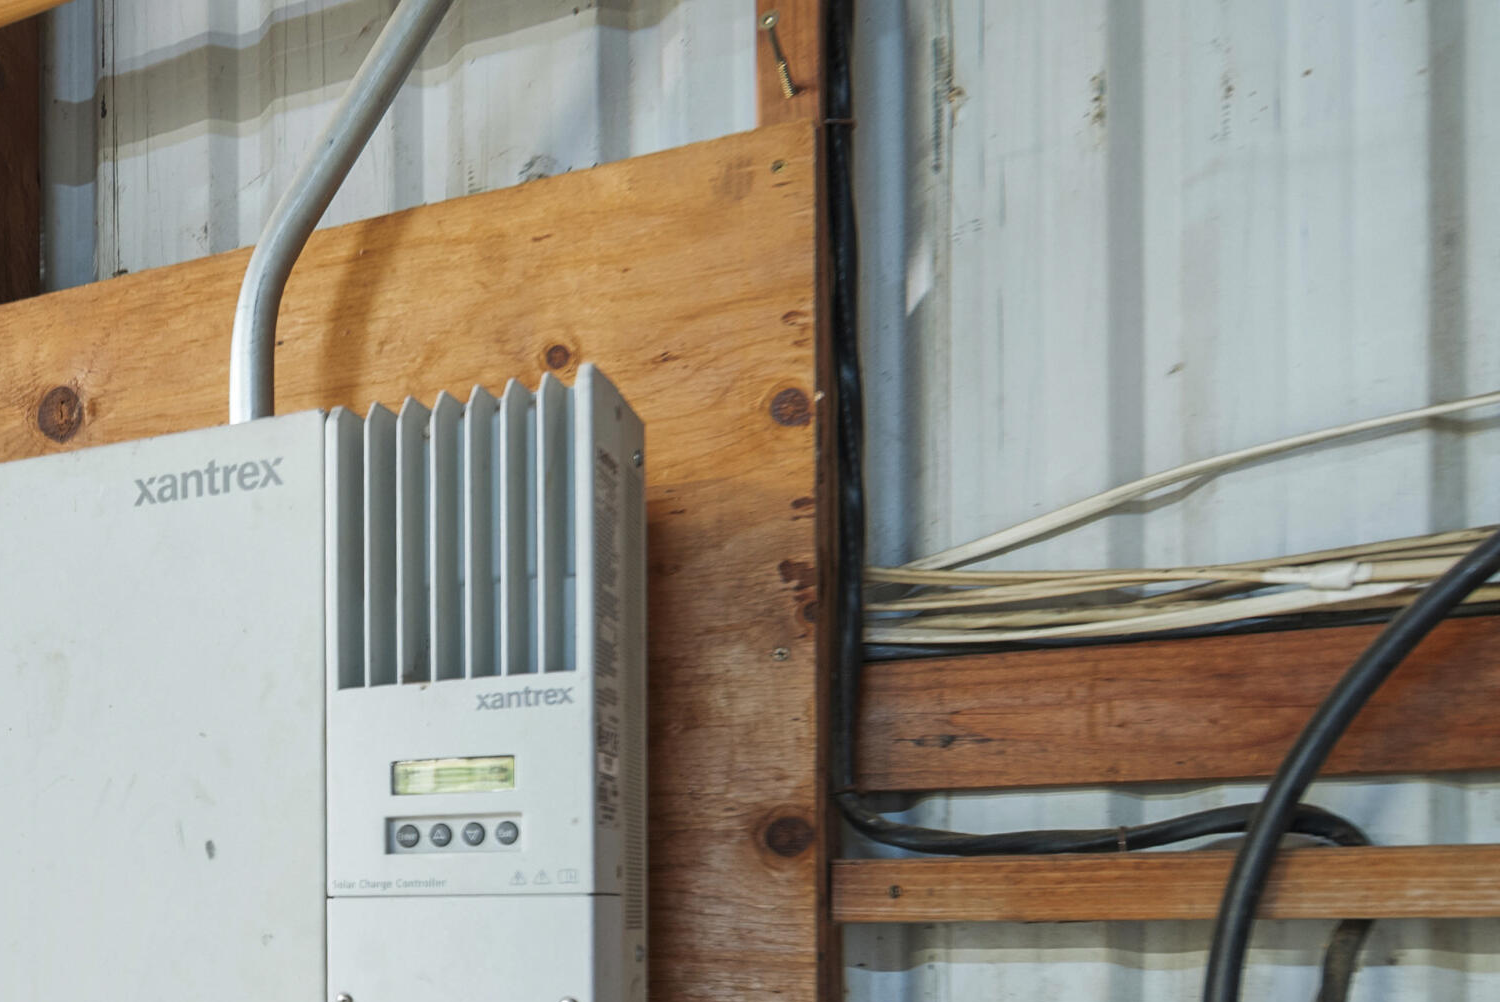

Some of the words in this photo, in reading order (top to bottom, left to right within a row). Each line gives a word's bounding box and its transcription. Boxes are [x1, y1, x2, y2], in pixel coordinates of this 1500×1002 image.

[134, 456, 284, 507] xantrex
[475, 685, 575, 711] xantrex
[360, 879, 392, 891] Charge
[395, 878, 447, 889] Controller
